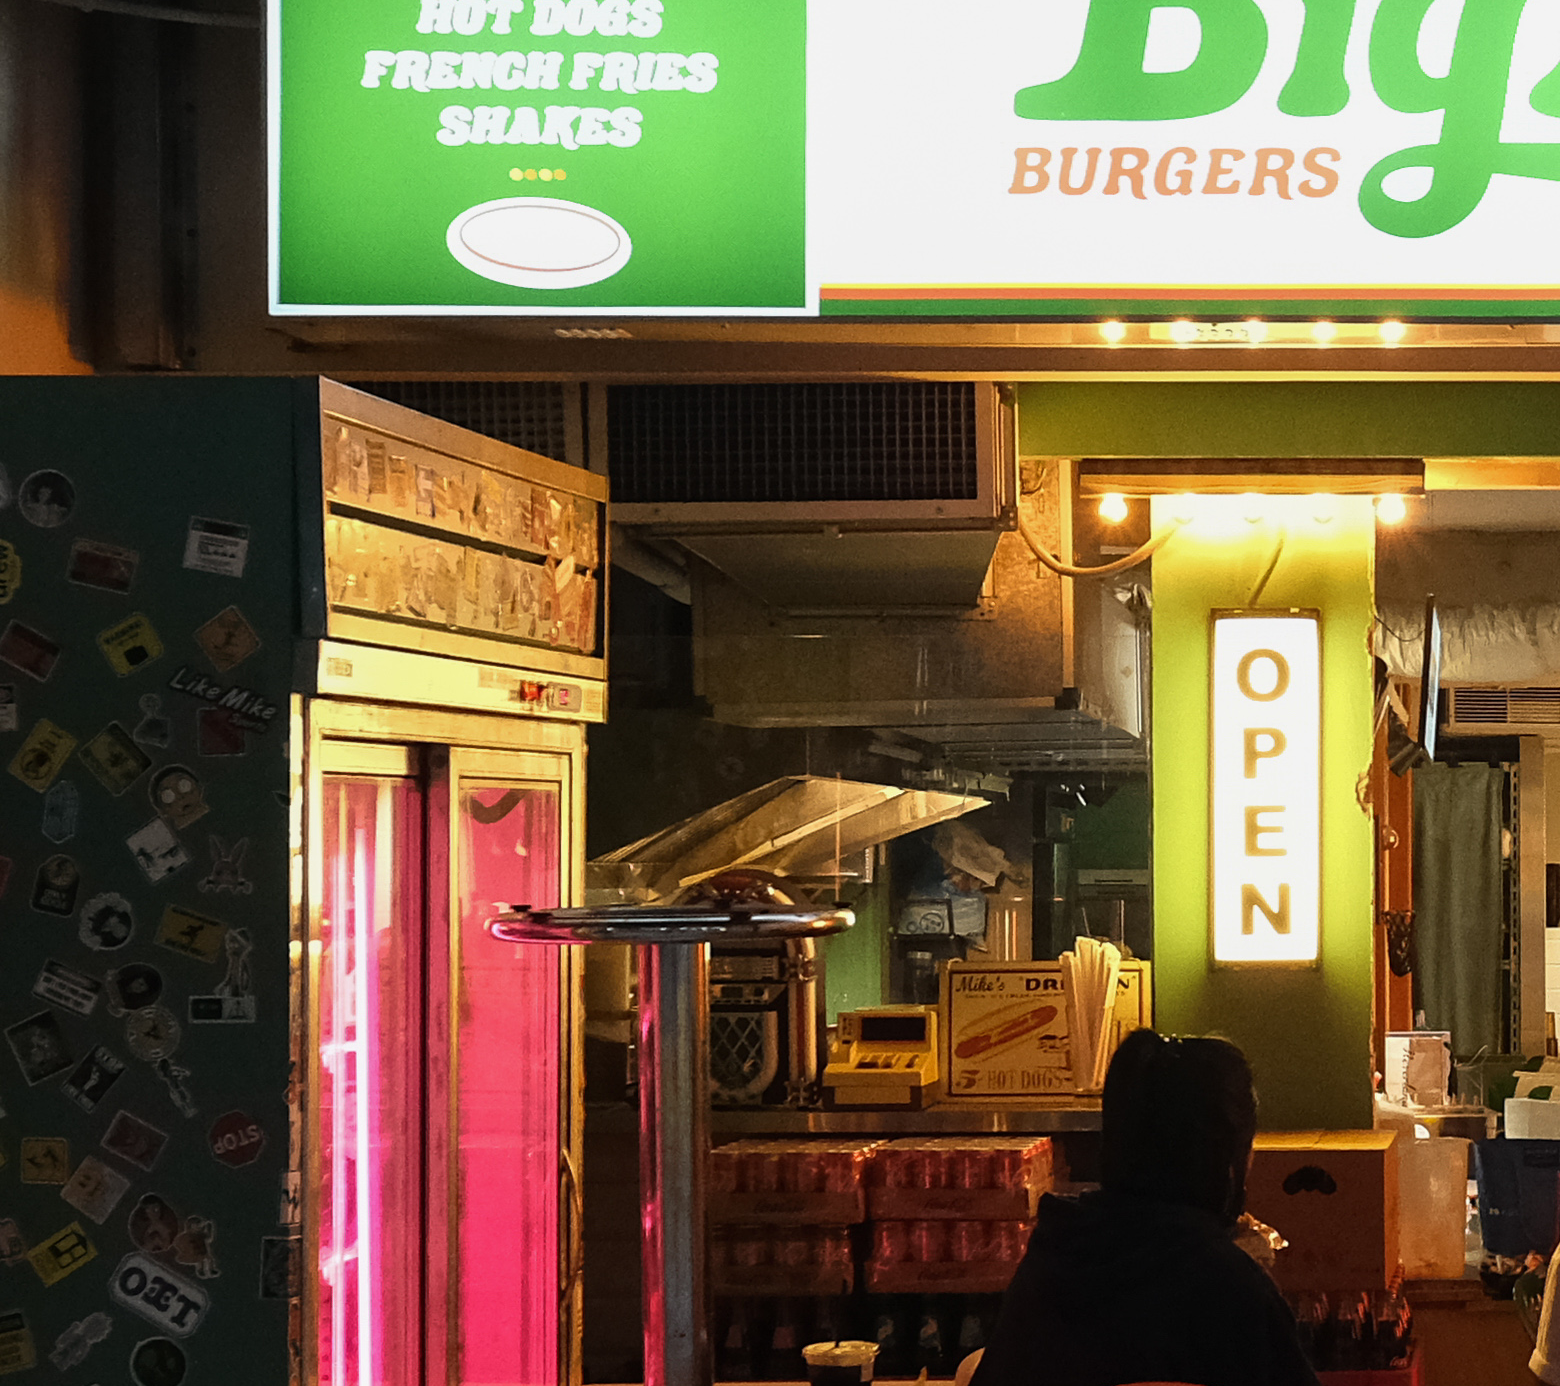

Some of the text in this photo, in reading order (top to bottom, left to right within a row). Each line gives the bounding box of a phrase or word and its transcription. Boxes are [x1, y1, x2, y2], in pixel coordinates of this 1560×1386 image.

[360, 50, 720, 94] FRENCH FRIES
[436, 105, 643, 150] SHAKES
[1008, 146, 1341, 200] BURGERS
[169, 668, 277, 721] Like Mike
[1235, 648, 1292, 936] OPEN
[955, 975, 1005, 992] Mike's
[214, 1125, 261, 1155] STOP
